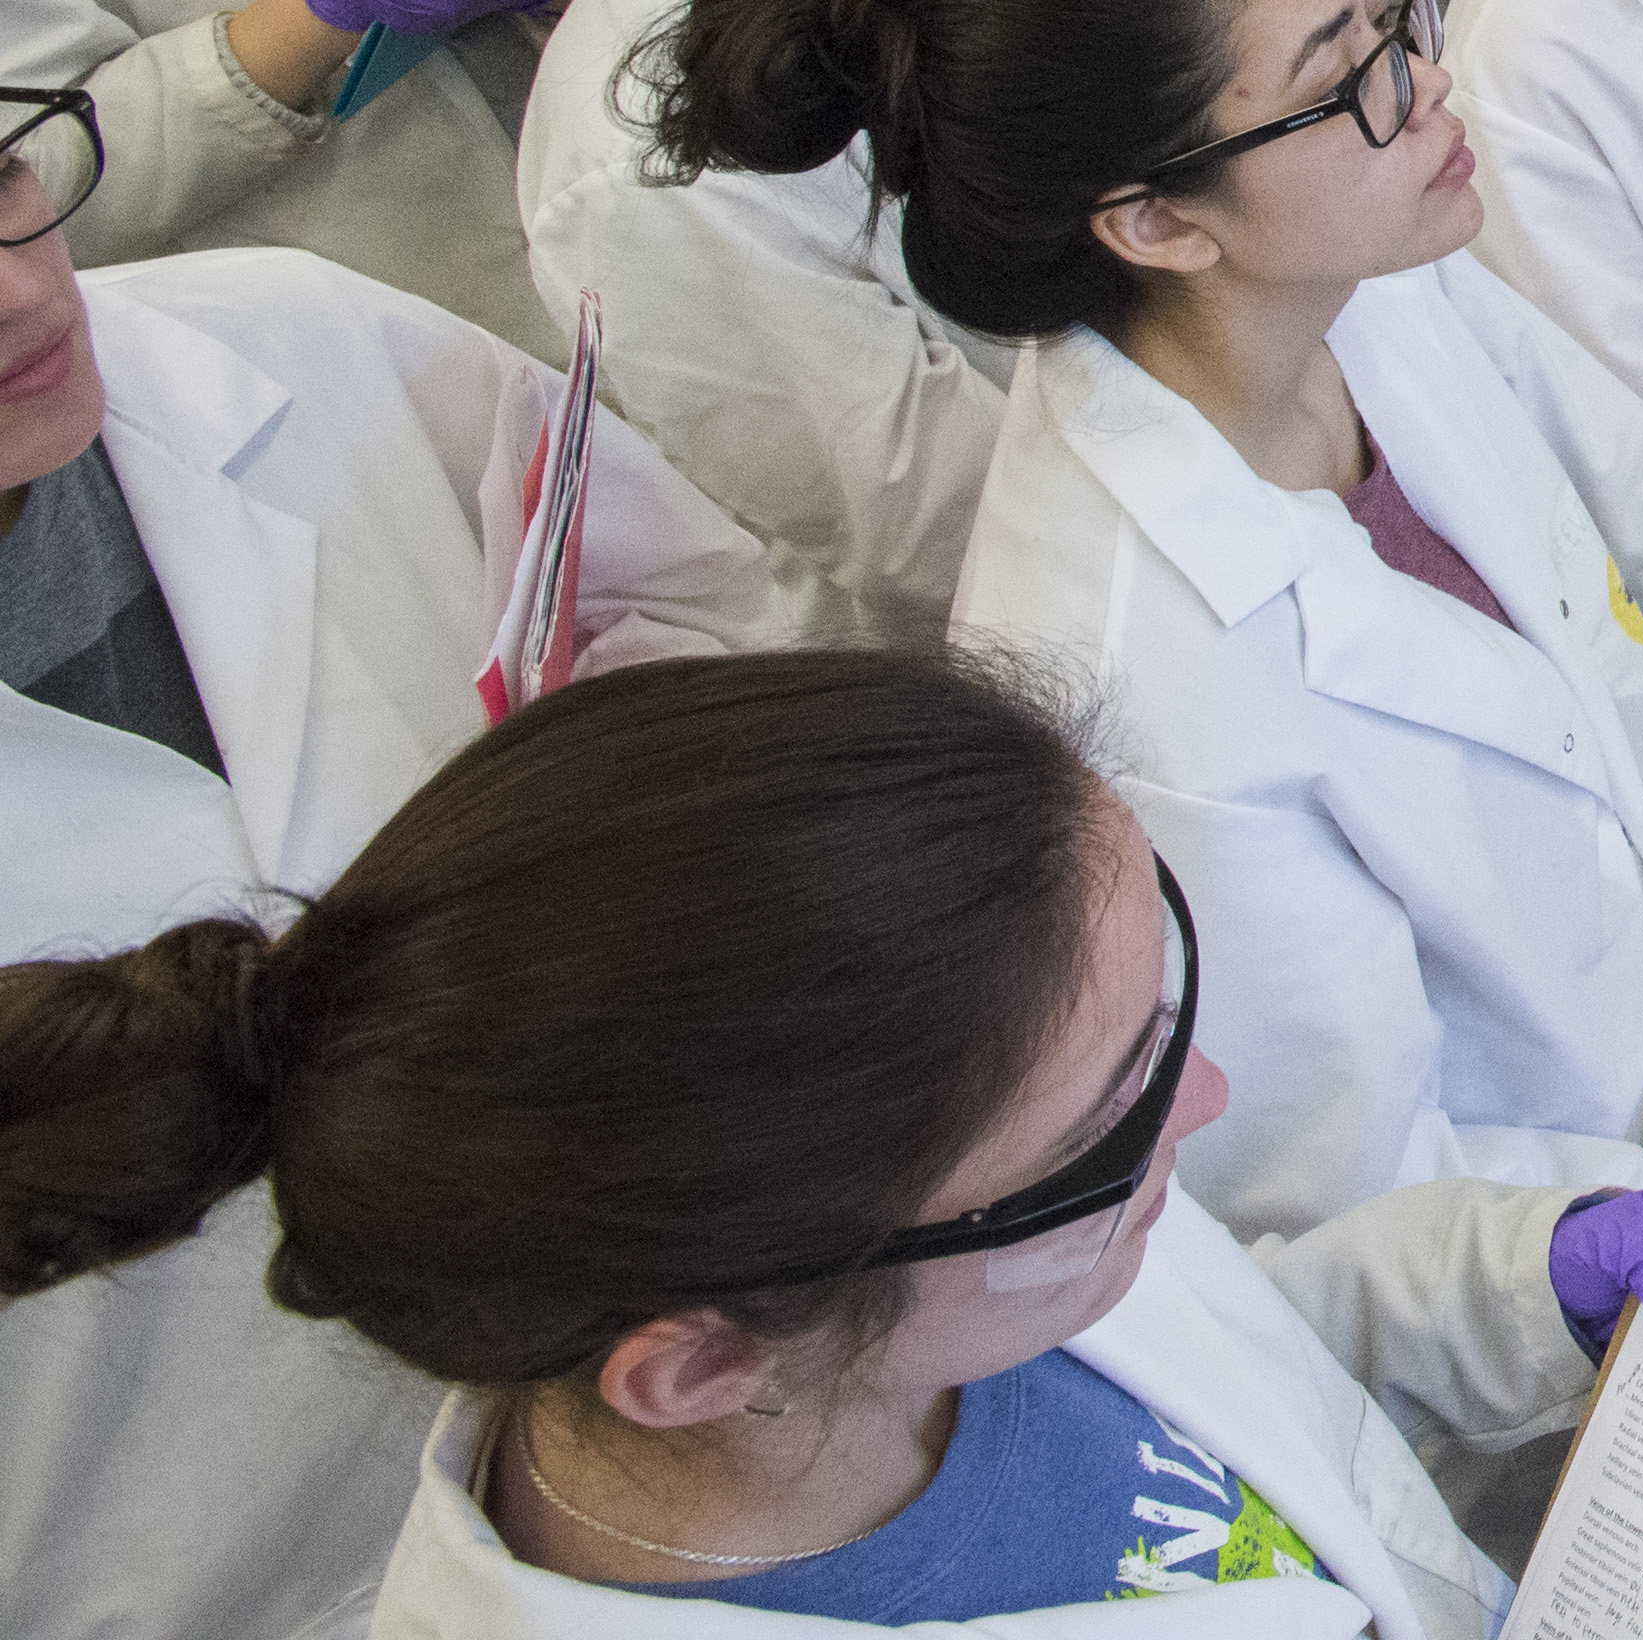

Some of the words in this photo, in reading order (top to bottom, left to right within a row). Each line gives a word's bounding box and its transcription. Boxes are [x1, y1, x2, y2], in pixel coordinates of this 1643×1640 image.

[1588, 1495, 1605, 1515] Veins
[1576, 1525, 1594, 1543] Great
[1593, 1538, 1627, 1564] saphenous
[1627, 1561, 1641, 1572] vein
[1582, 1511, 1602, 1528] Dorsal
[1601, 1526, 1624, 1544] venous
[1623, 1539, 1639, 1553] arch
[1563, 1556, 1590, 1578] Anterior
[1605, 1584, 1620, 1598] vein
[1570, 1540, 1598, 1564] Posterior
[1597, 1559, 1614, 1574] tibial
[1613, 1572, 1629, 1584] vein
[1551, 1586, 1577, 1608] Femoral
[1576, 1604, 1592, 1617] vein
[1584, 1590, 1598, 1602] vein
